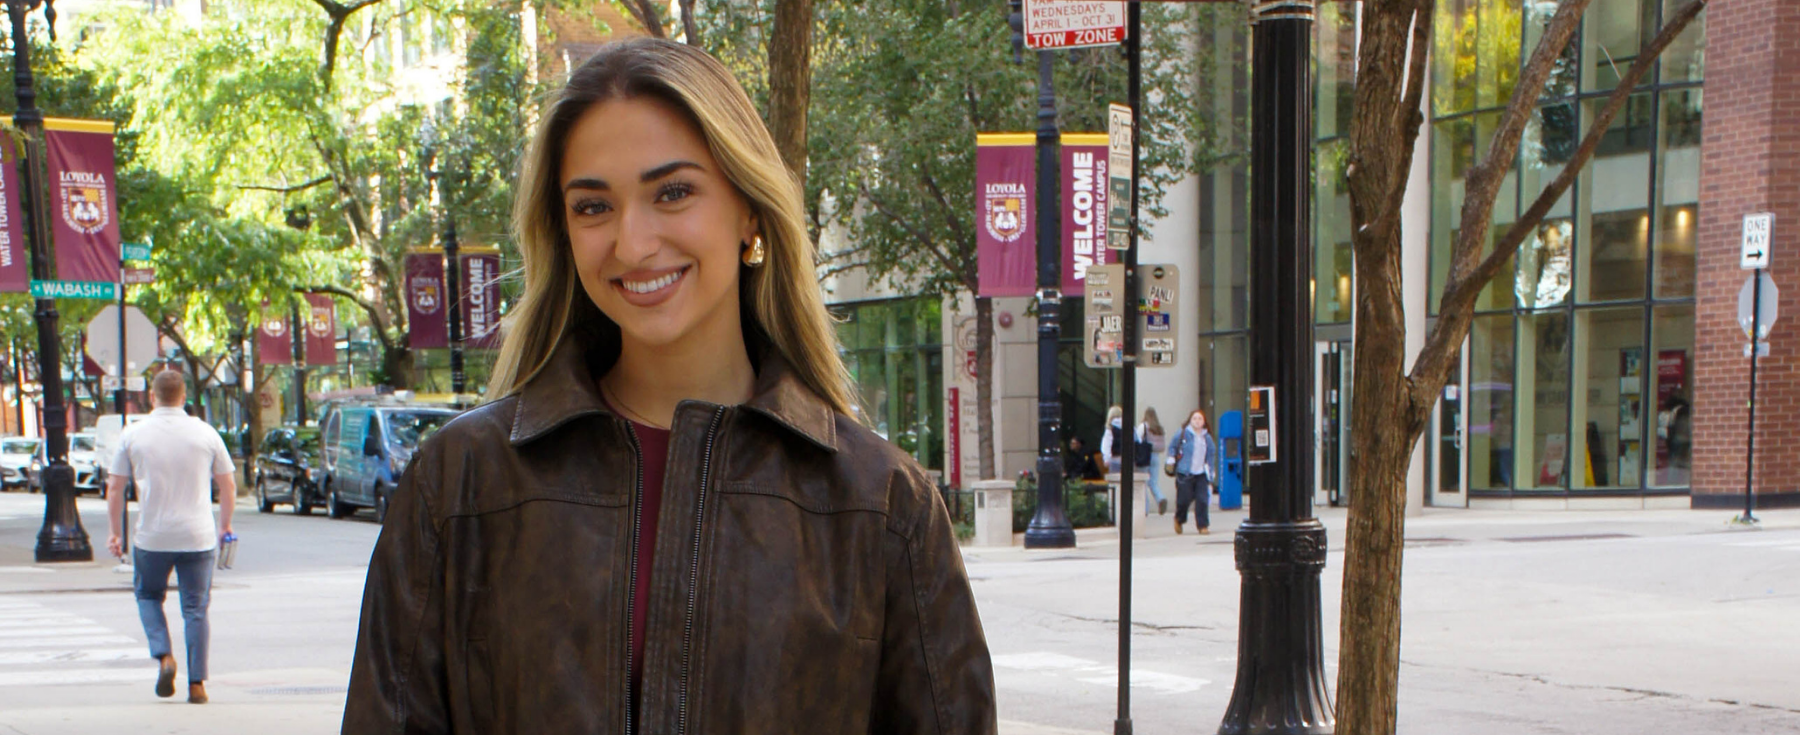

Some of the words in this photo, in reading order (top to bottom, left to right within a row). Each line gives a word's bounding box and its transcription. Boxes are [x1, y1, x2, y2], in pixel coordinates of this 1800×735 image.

[1033, 3, 1106, 18] WEDNESDAYS
[1033, 18, 1062, 30] APRIL
[1082, 15, 1101, 27] OCT
[1033, 32, 1066, 47] TOW
[1074, 28, 1117, 45] ZONE
[59, 170, 105, 183] LOYOLA
[1096, 160, 1106, 201] CAMPUS
[985, 183, 1026, 194] LOYOLA
[1073, 152, 1093, 280] WELCOME
[1096, 203, 1106, 237] TOWER
[1748, 219, 1767, 231] ONE
[1747, 234, 1767, 246] WAY
[42, 282, 101, 296] WABASH
[470, 258, 485, 338] WELCOME
